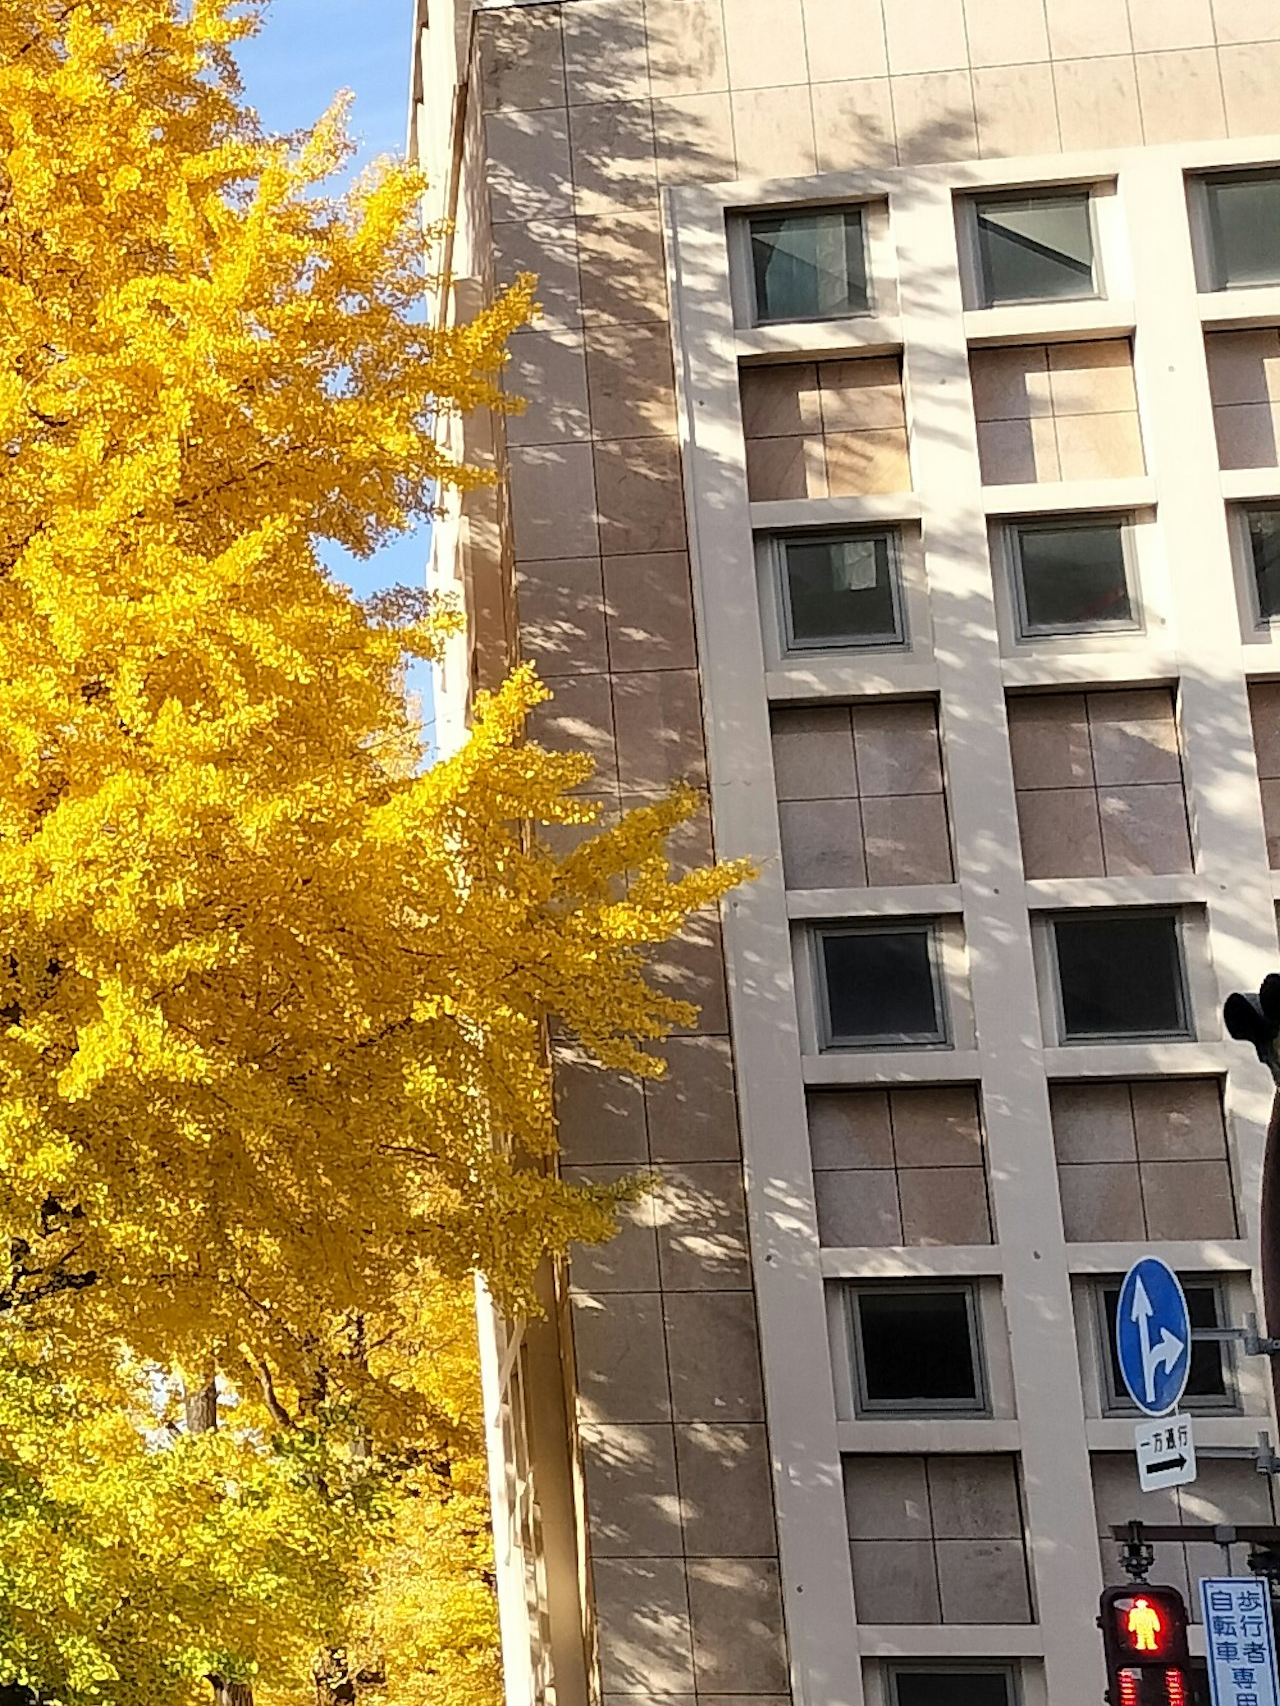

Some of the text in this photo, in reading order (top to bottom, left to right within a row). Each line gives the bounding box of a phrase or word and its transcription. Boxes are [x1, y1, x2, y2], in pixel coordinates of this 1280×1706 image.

[1140, 1424, 1188, 1453] 一方通行
[1210, 1589, 1241, 1664] 自転車
[1237, 1590, 1267, 1664] 歩行者
